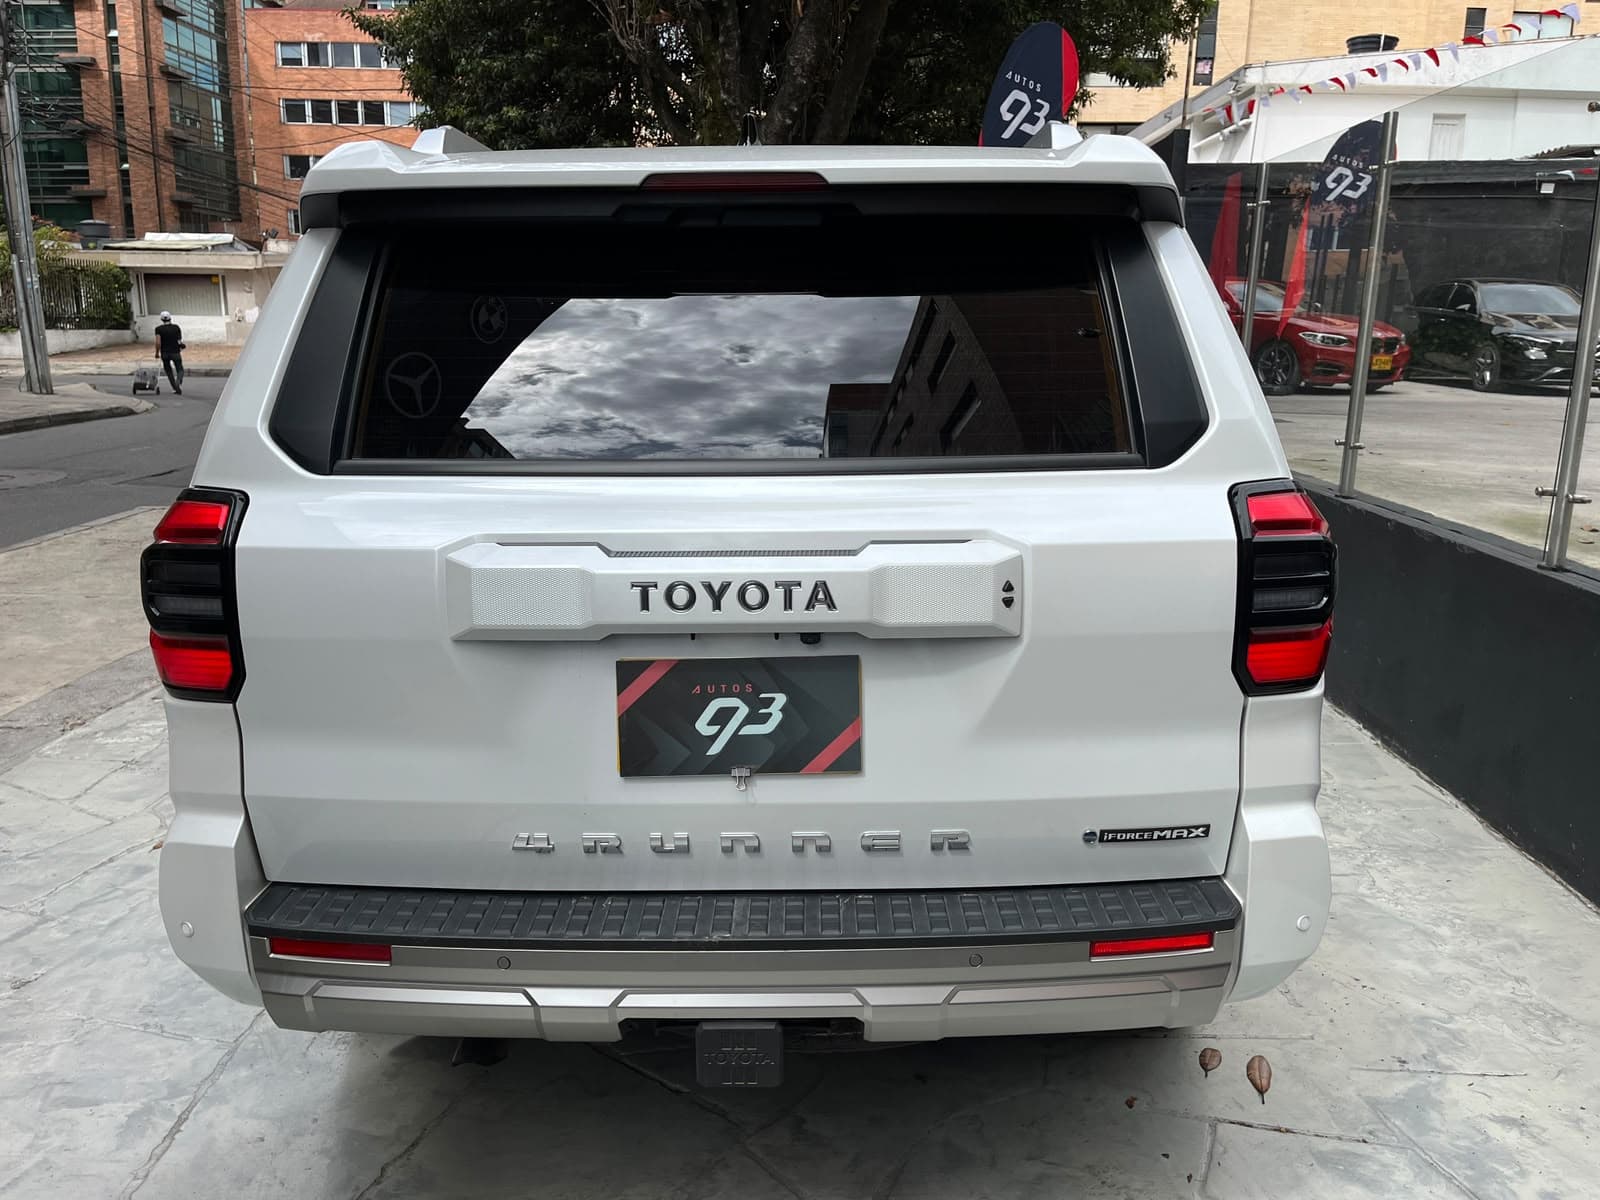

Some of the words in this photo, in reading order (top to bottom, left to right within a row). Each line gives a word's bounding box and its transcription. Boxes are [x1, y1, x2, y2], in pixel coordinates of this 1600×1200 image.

[1005, 70, 1041, 92] AUTOS
[1000, 89, 1050, 139] 93
[1325, 166, 1372, 201] 93
[630, 580, 838, 613] TOYOTA
[692, 683, 753, 694] AUTOS
[695, 693, 787, 756] 93
[512, 829, 971, 854] 4RUNNER
[703, 1053, 776, 1065] TOYOTA
